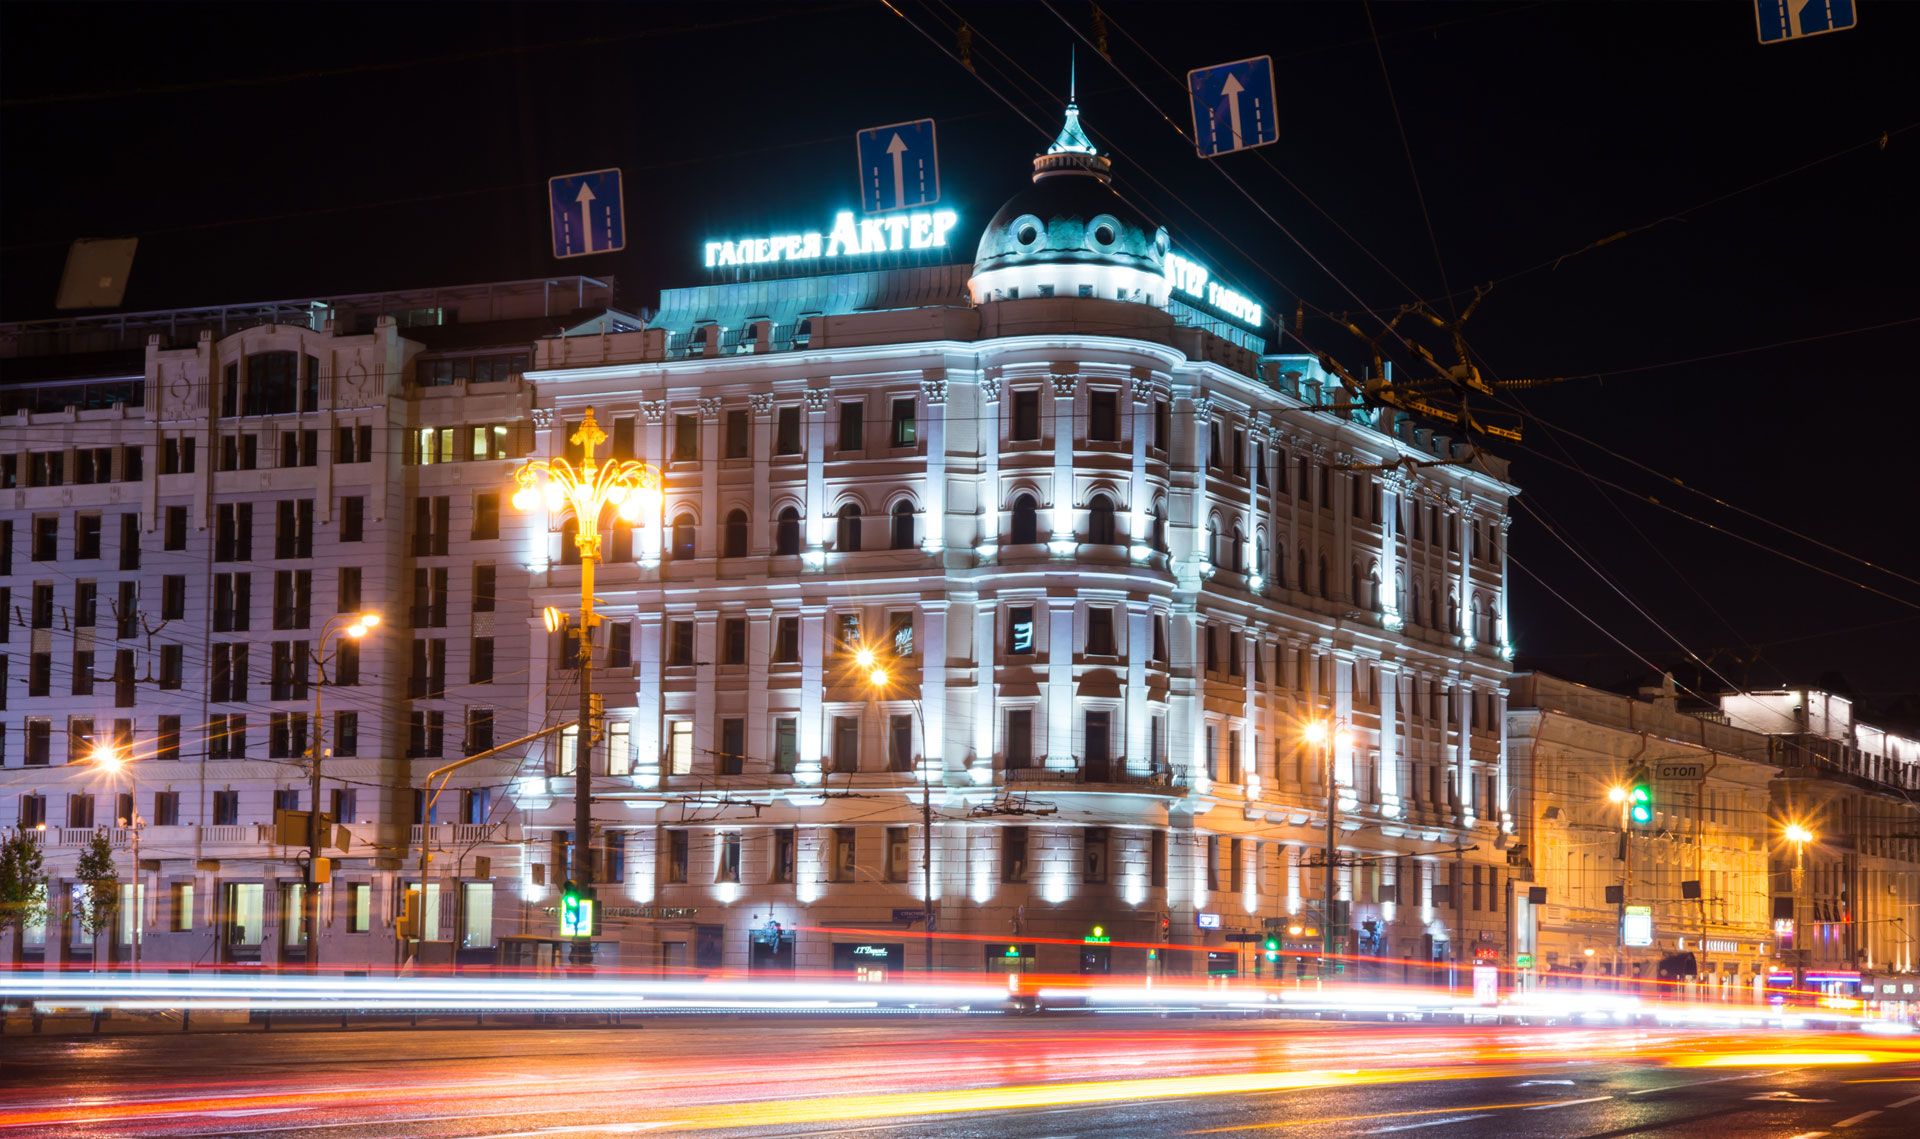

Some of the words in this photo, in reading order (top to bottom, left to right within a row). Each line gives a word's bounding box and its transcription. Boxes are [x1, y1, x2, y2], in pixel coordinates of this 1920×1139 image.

[705, 233, 822, 267] ГАЛЕРЕЯ
[825, 211, 958, 257] АКТЕР
[1663, 767, 1696, 777] СТОП
